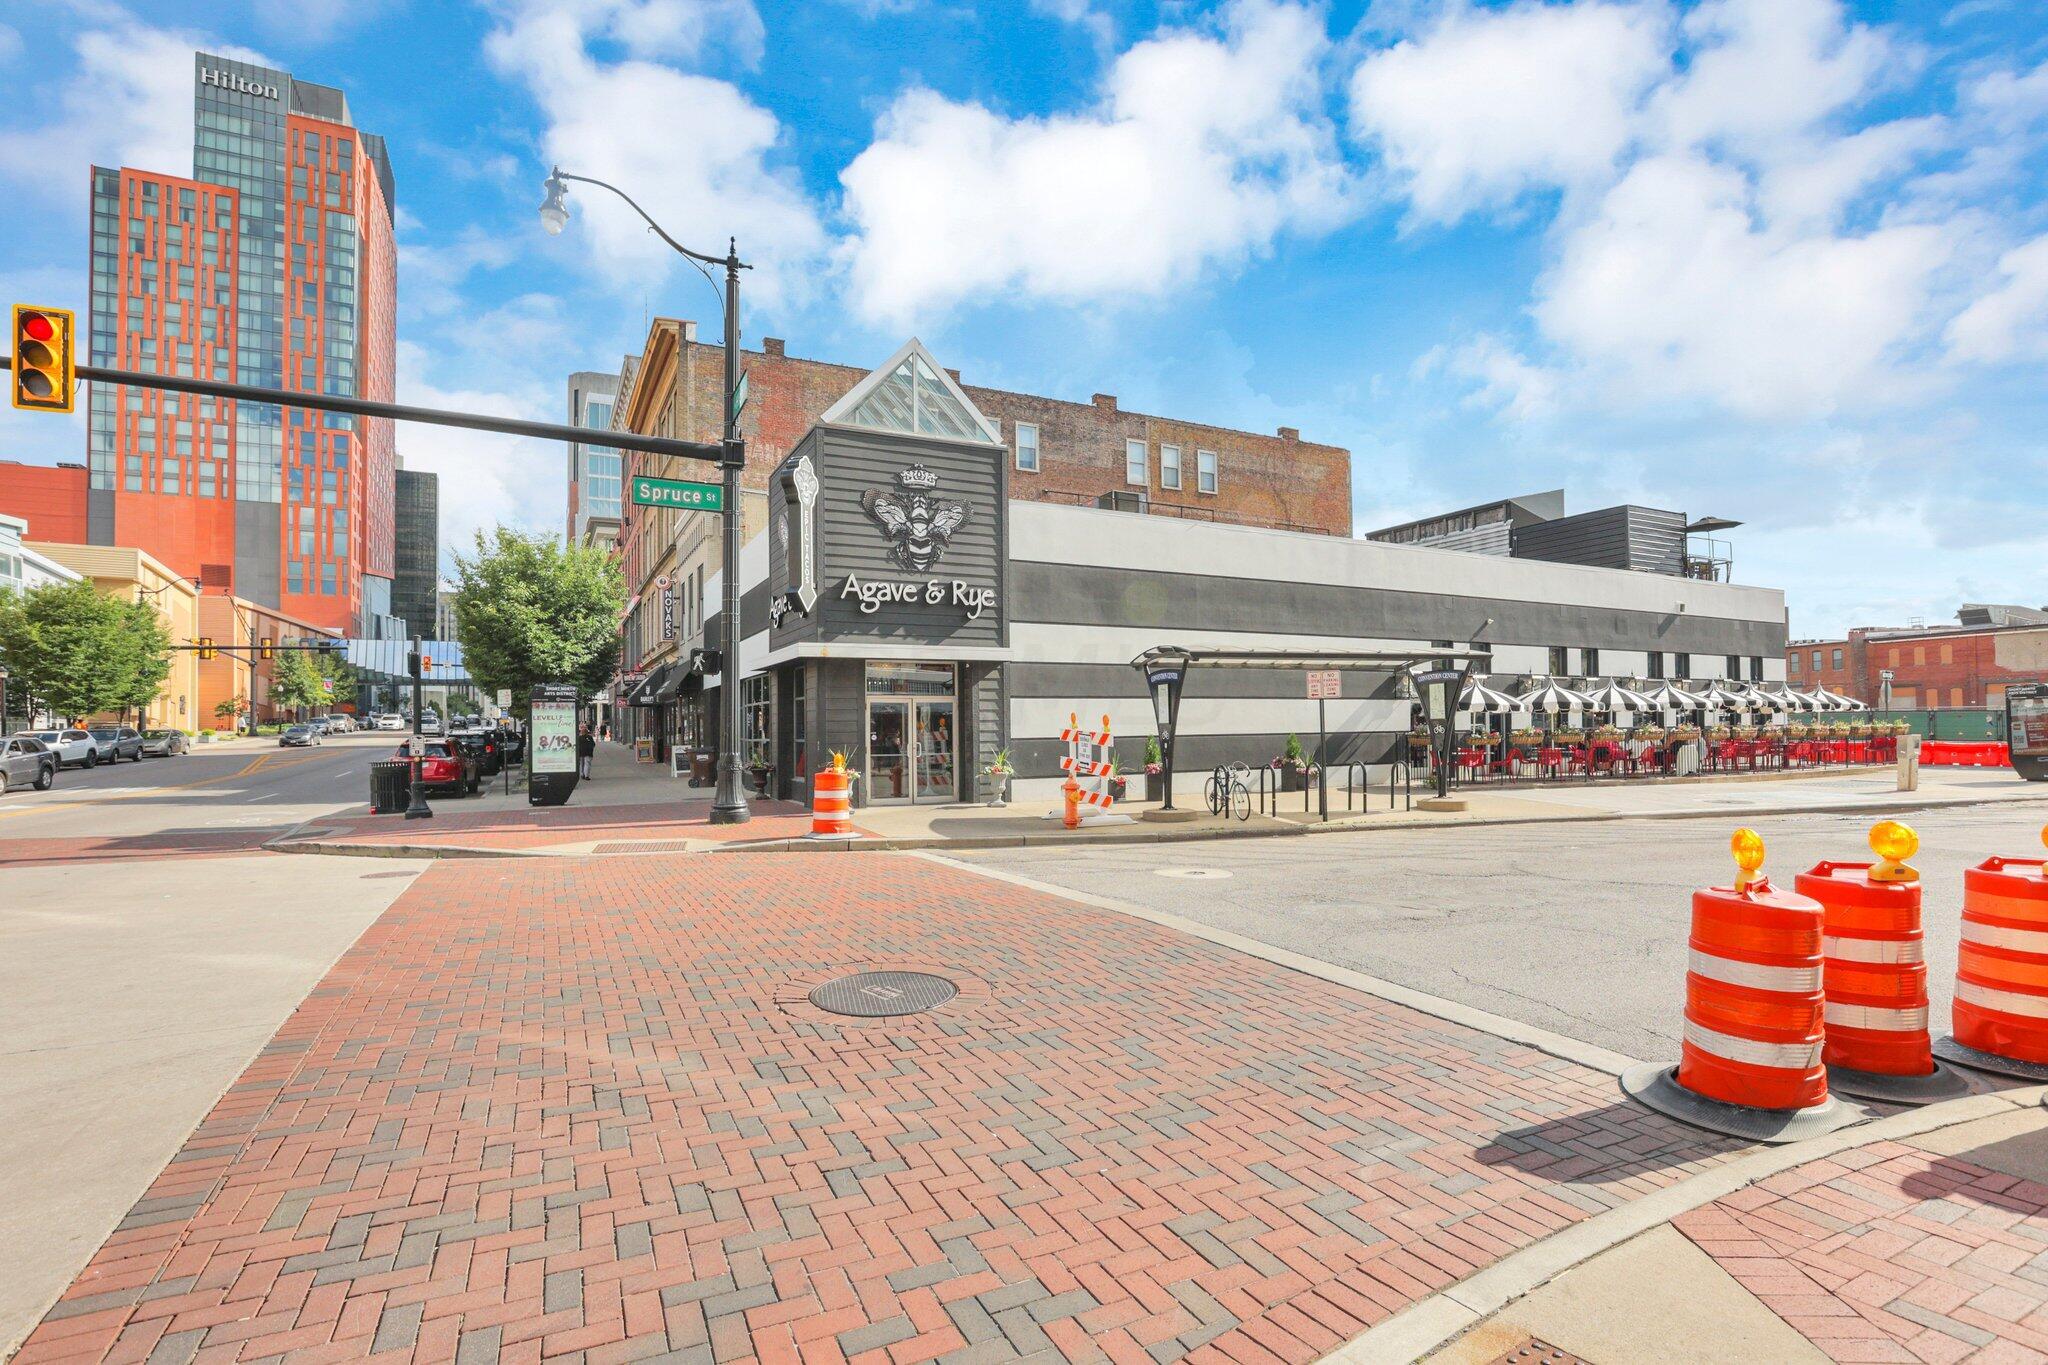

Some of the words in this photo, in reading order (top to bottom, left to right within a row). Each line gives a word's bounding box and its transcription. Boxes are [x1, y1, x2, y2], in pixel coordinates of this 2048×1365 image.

[201, 66, 279, 100] Hilton
[640, 483, 702, 503] Spruce
[706, 493, 716, 502] St
[841, 572, 918, 614] Agave
[925, 579, 946, 605] &
[952, 580, 996, 620] Rye
[664, 590, 673, 638] NOVAKS
[1417, 673, 1442, 683] CONVENTION
[1442, 672, 1459, 680] CENTER
[539, 735, 570, 748] 8/19
